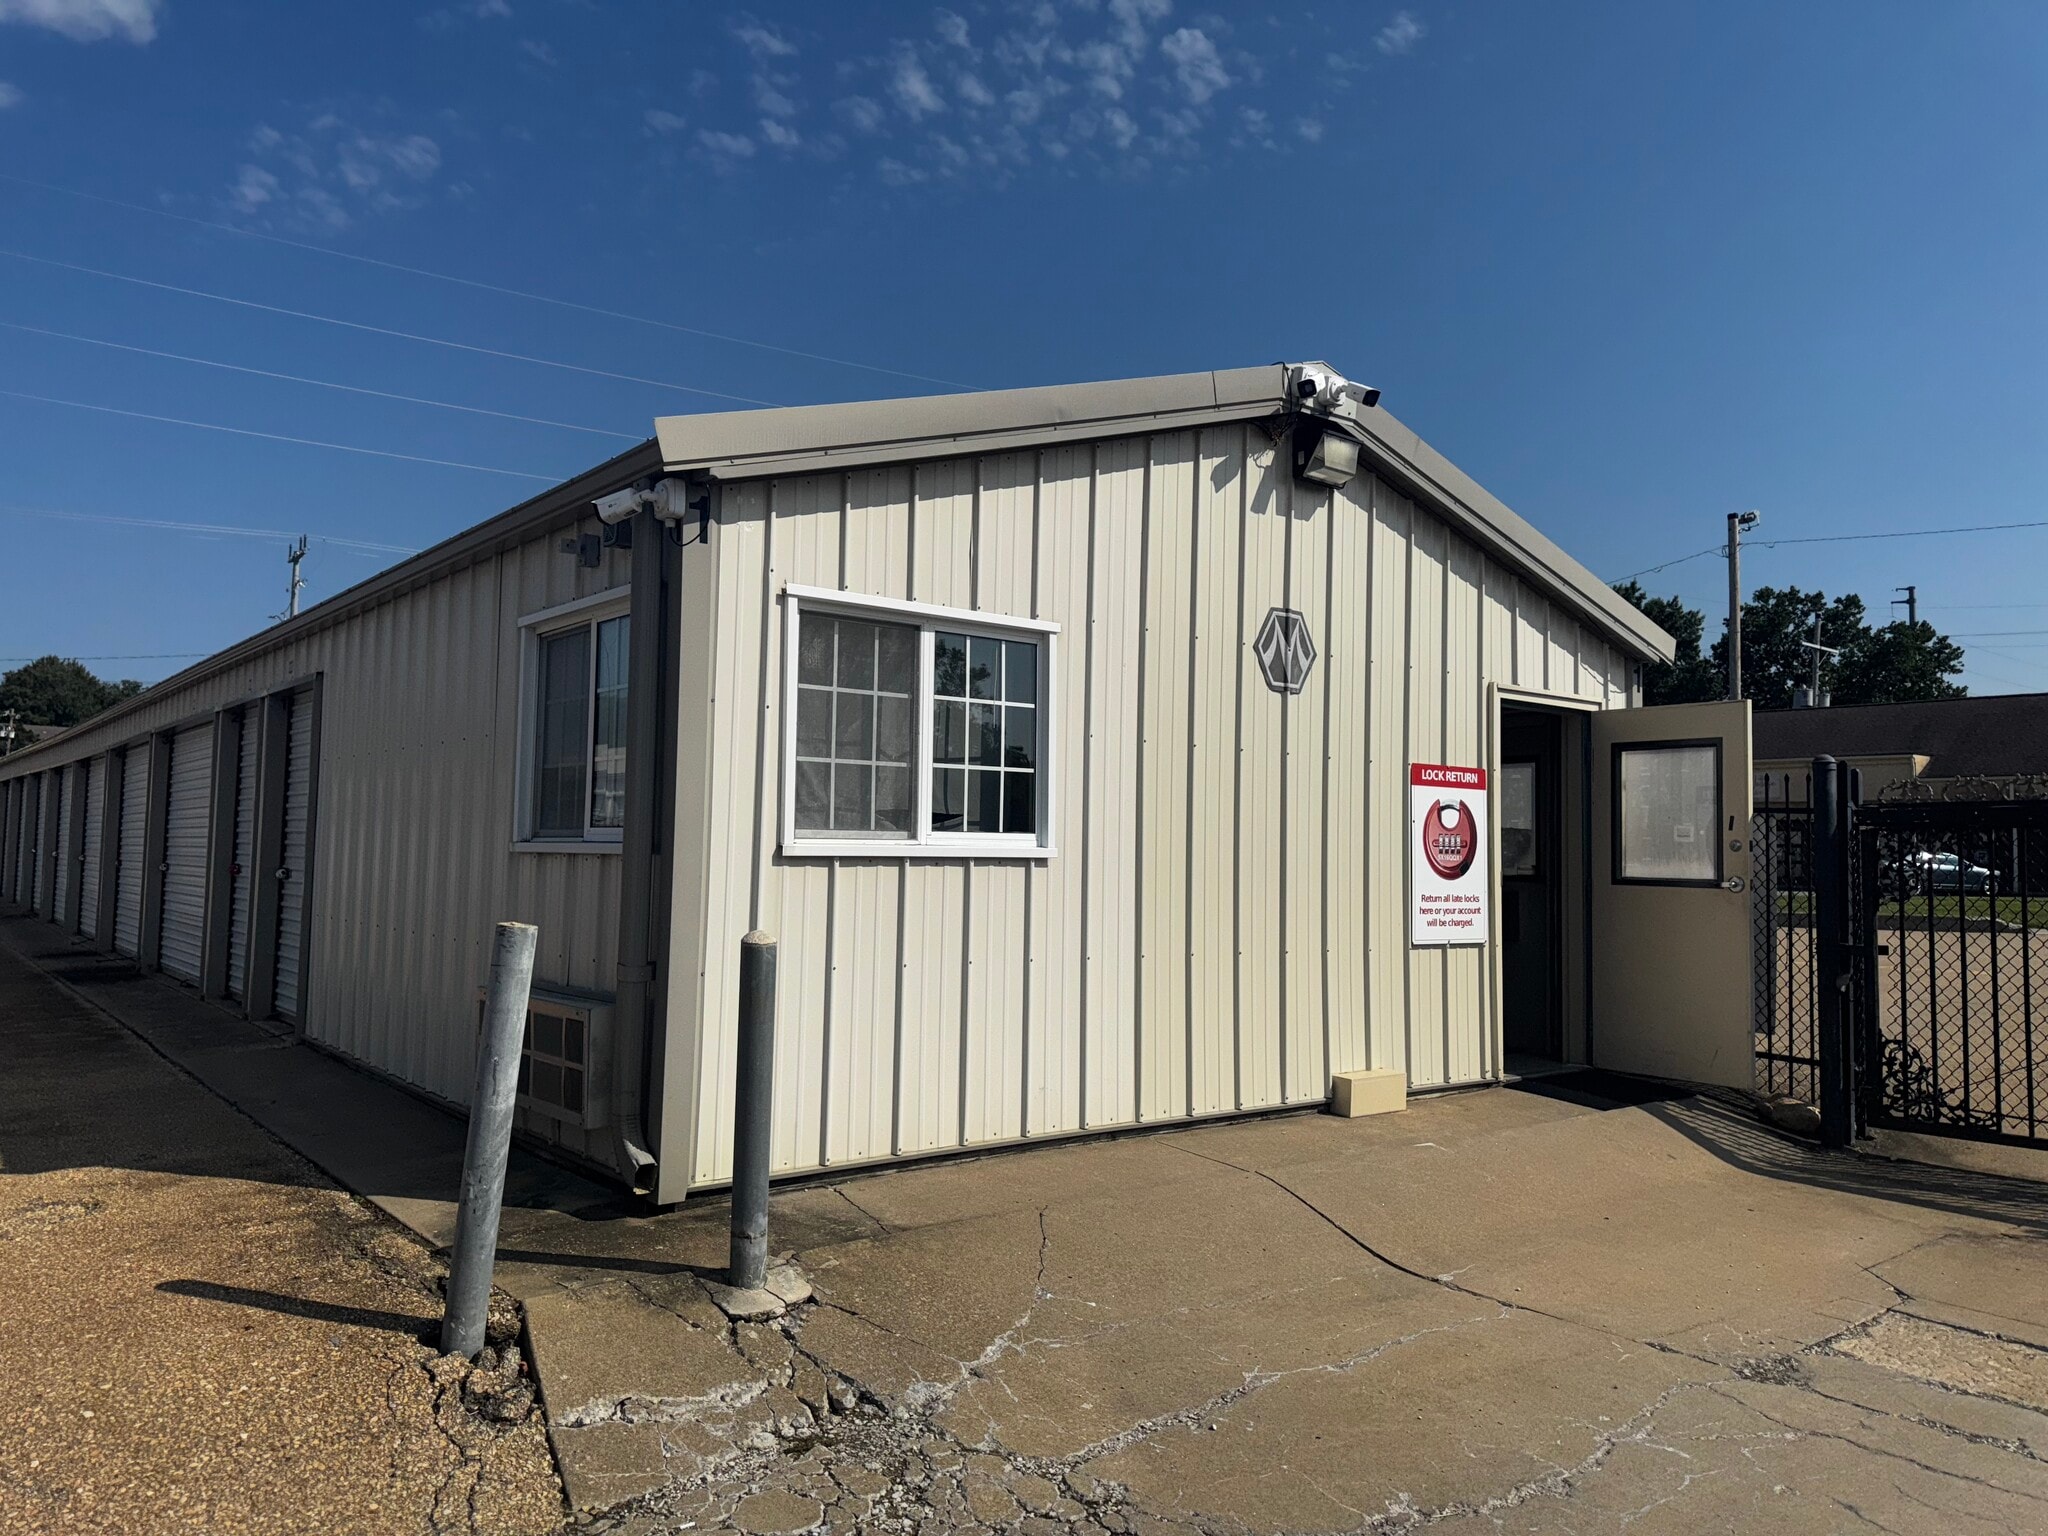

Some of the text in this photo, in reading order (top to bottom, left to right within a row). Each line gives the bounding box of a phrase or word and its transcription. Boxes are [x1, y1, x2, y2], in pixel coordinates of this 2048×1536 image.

[1421, 769, 1478, 783] LOCK RETURN
[1421, 894, 1442, 902] Return
[1451, 894, 1463, 902] late
[1464, 894, 1480, 902] locks
[1419, 906, 1434, 914] here
[1442, 908, 1457, 916] your
[1426, 918, 1474, 928] will be charged.
